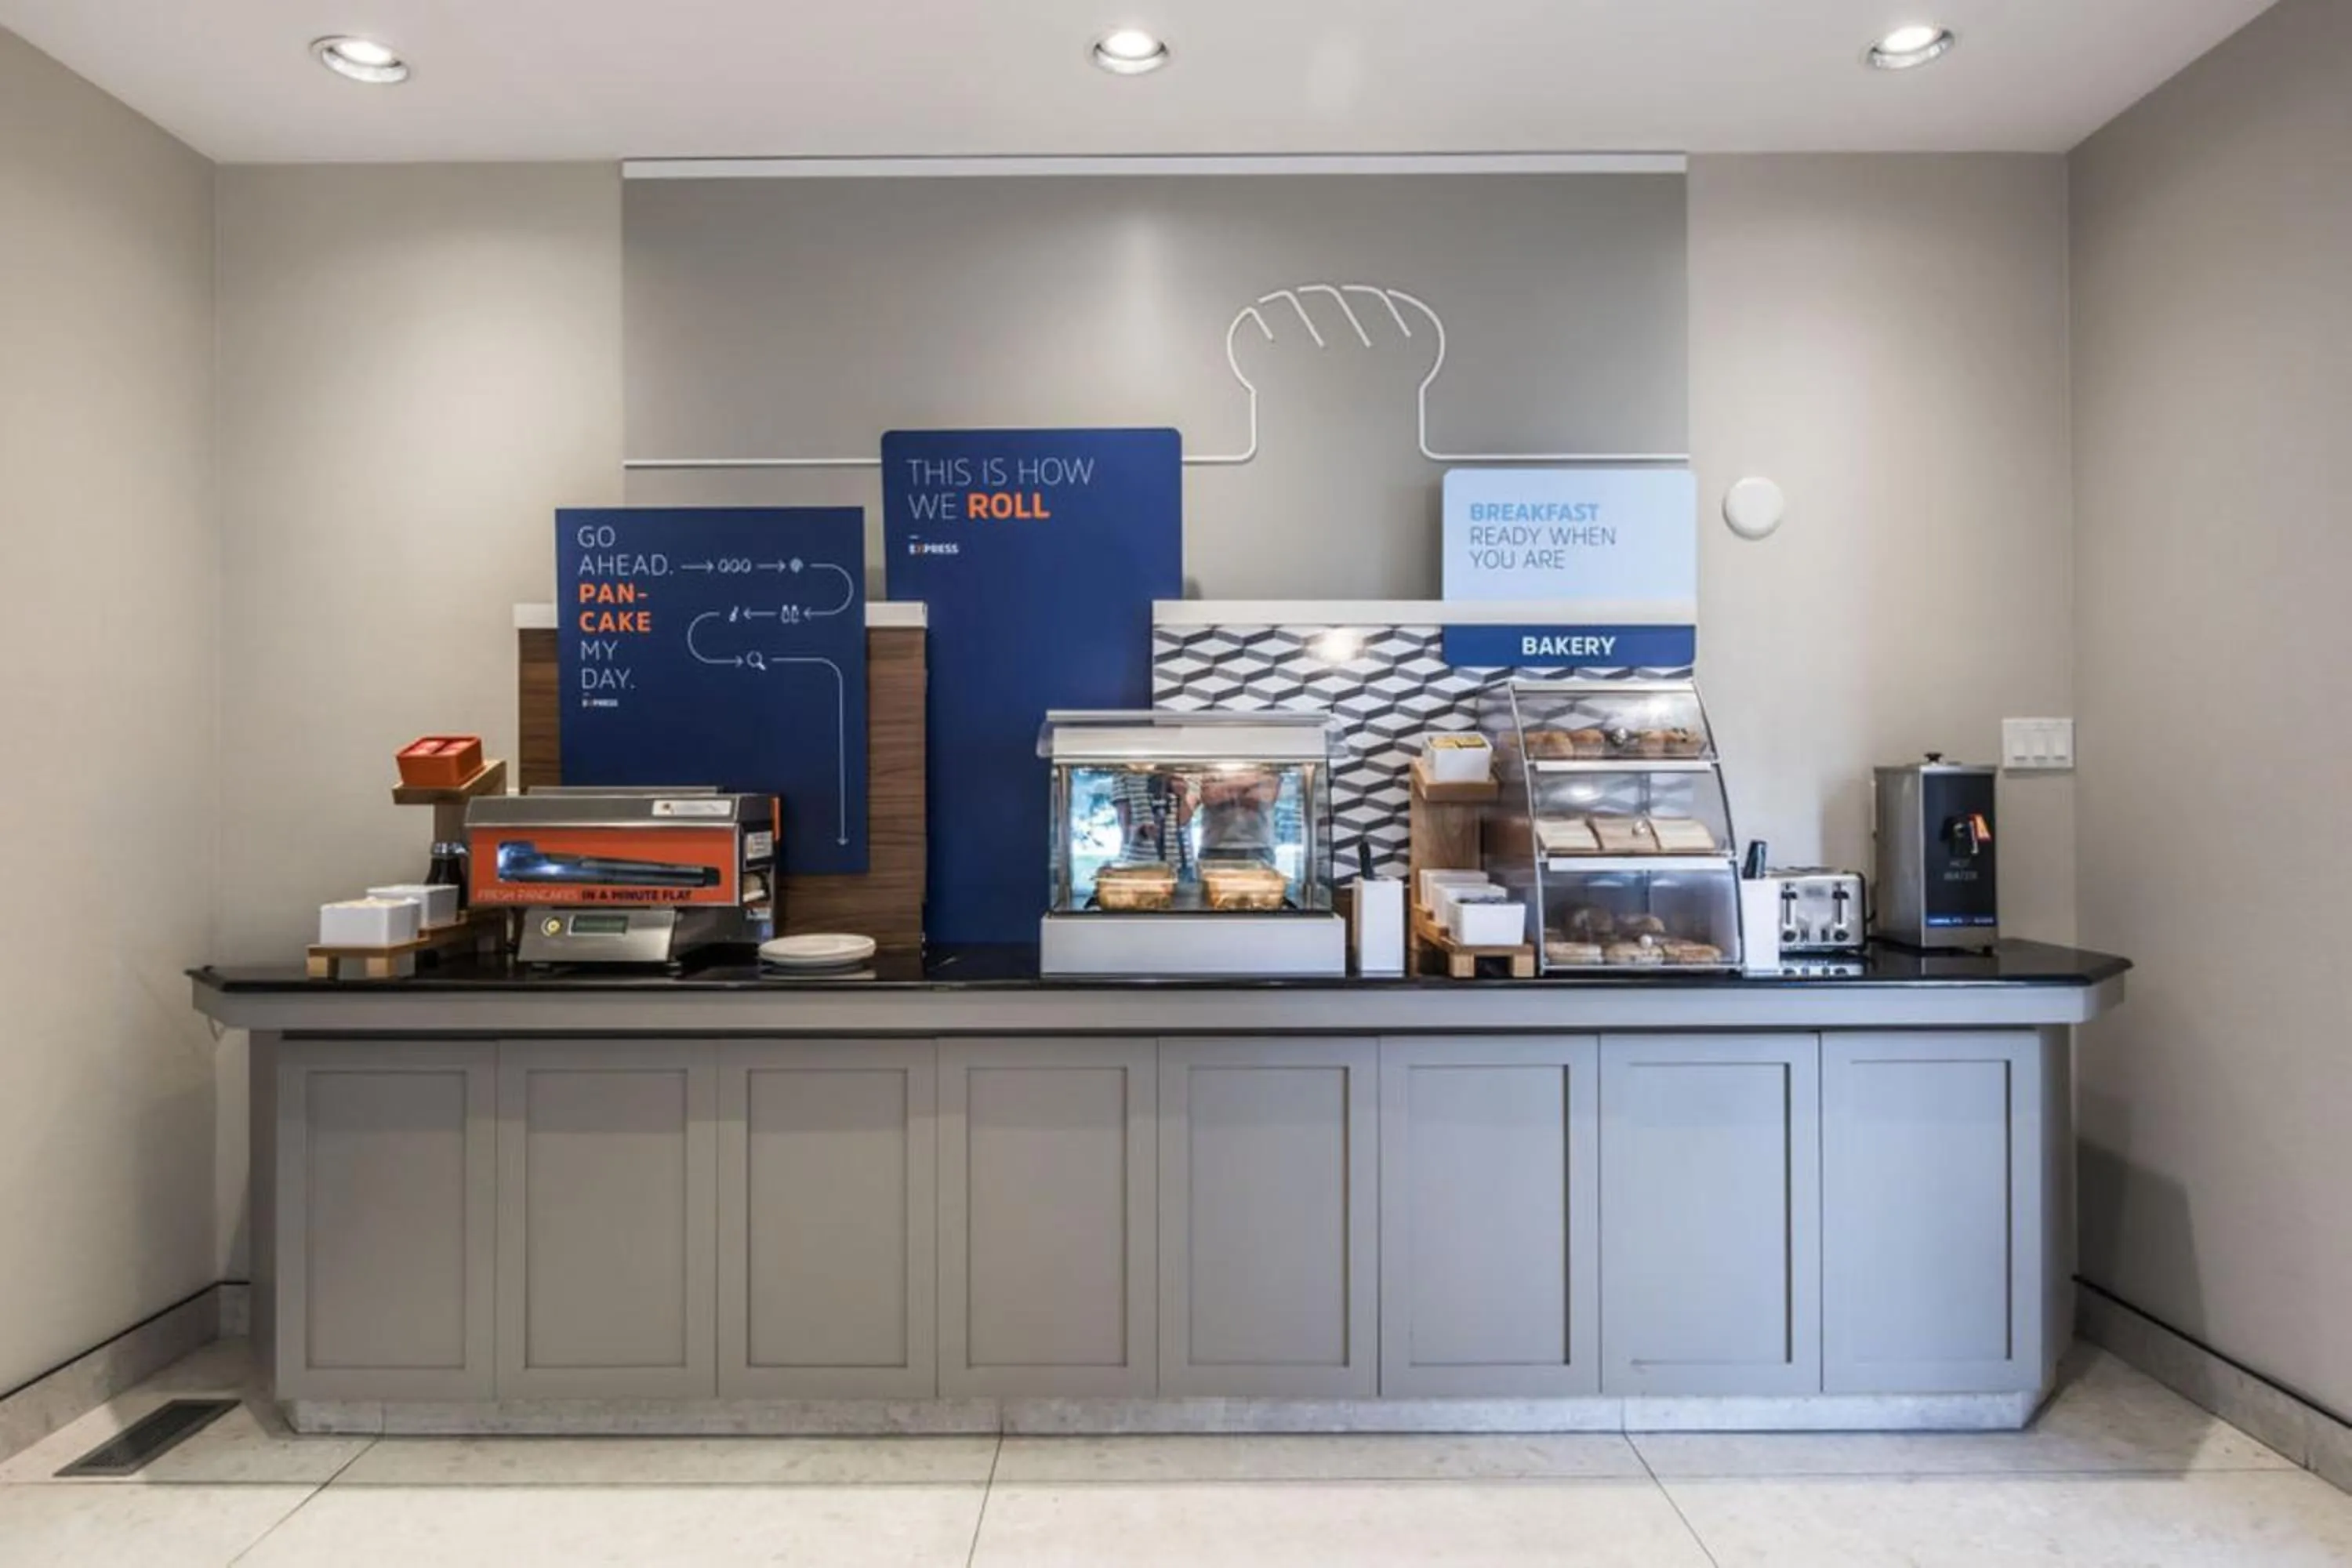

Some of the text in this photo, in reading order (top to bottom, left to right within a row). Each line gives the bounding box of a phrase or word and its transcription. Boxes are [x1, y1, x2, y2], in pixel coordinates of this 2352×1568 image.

[906, 457, 1094, 486] THIS IS HOW
[907, 492, 1051, 520] WE ROLL
[1469, 503, 1599, 522] BREAKFAST
[577, 525, 615, 549] GO
[1469, 526, 1617, 546] READY WHEN
[909, 543, 960, 555] EXPRESS
[1469, 549, 1566, 569] YOU ARE
[579, 554, 674, 576] AHEAD.
[579, 583, 649, 604] PAN-
[579, 612, 652, 633] CAKE
[580, 640, 619, 661] MY
[1521, 636, 1617, 656] BAKERY
[581, 668, 636, 689] DAY.
[582, 890, 595, 901] IN
[599, 890, 609, 900] A
[612, 889, 658, 901] MINUTE
[662, 889, 691, 901] FLAT
